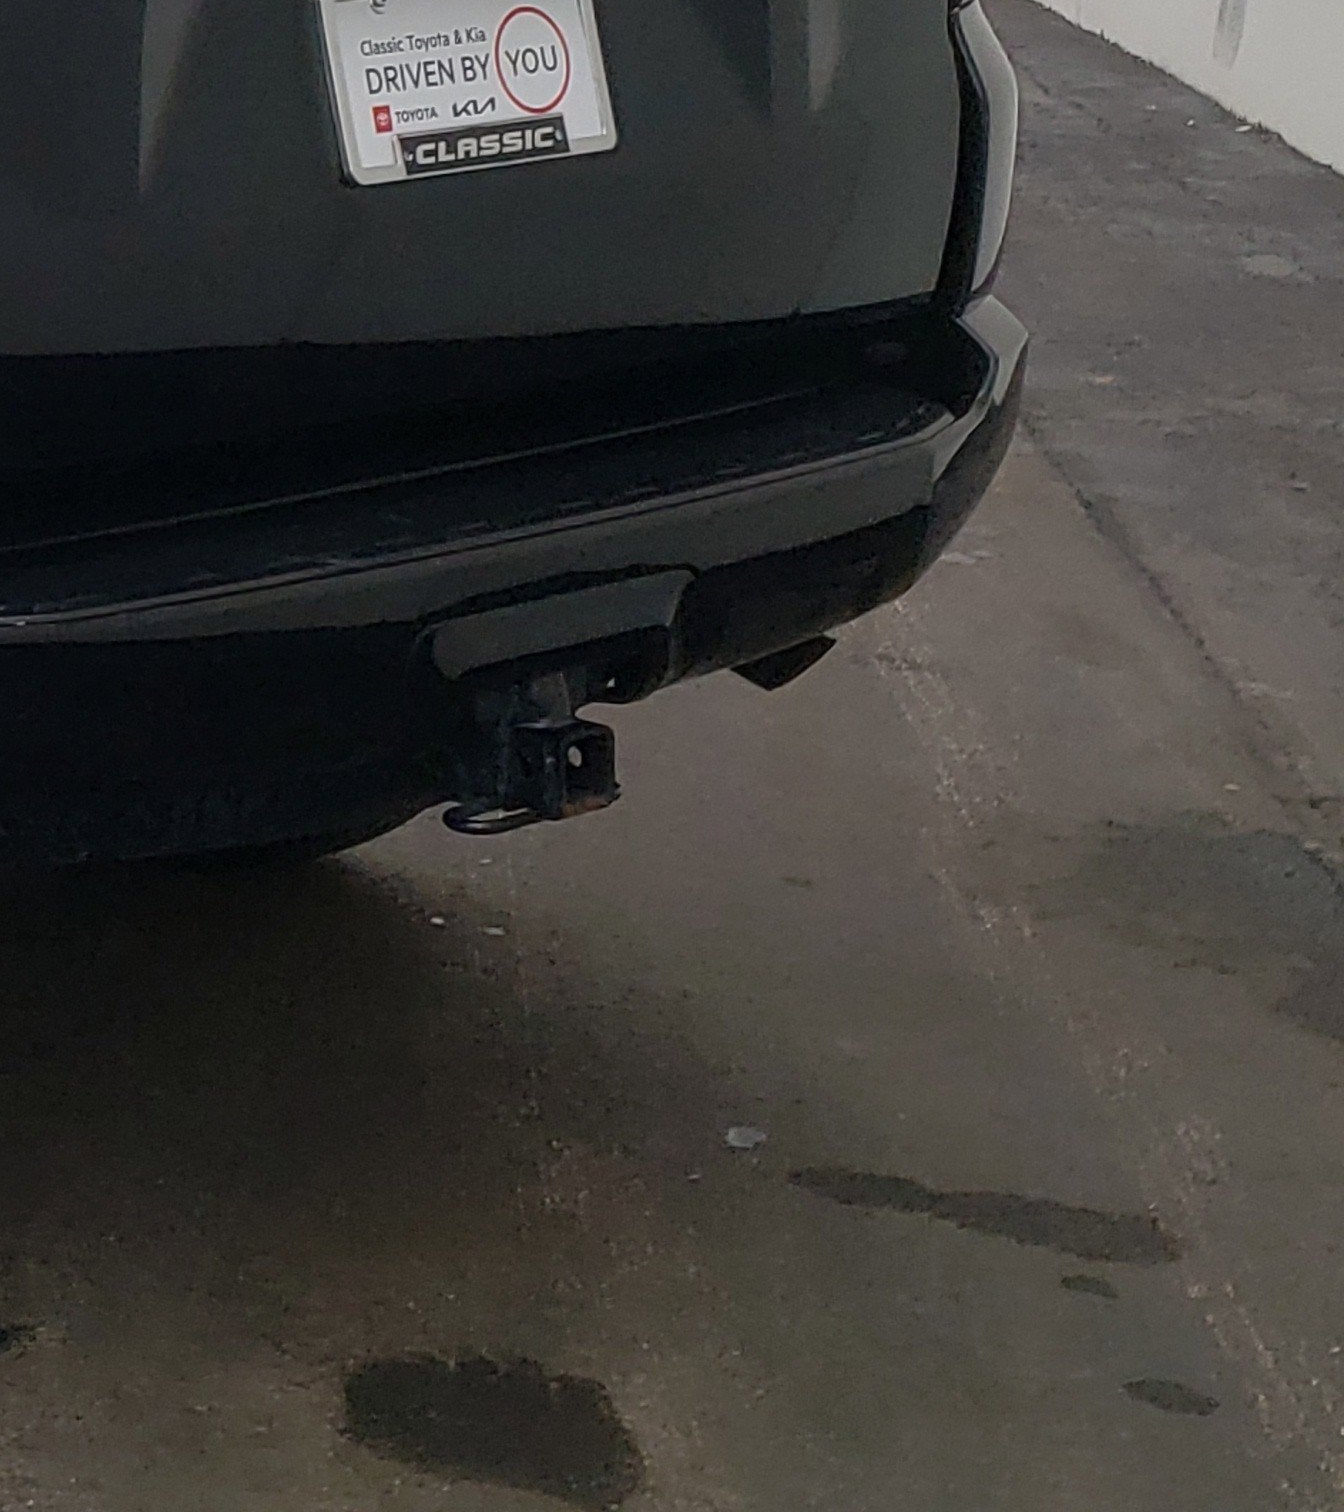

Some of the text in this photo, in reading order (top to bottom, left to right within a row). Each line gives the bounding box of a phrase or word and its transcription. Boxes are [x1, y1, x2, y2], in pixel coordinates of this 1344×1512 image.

[360, 27, 487, 56] Classic Toyota & Kia
[365, 45, 558, 95] DRIVEN BY YOU
[395, 106, 439, 124] TOYOTA
[415, 125, 555, 166] CLASSIC
